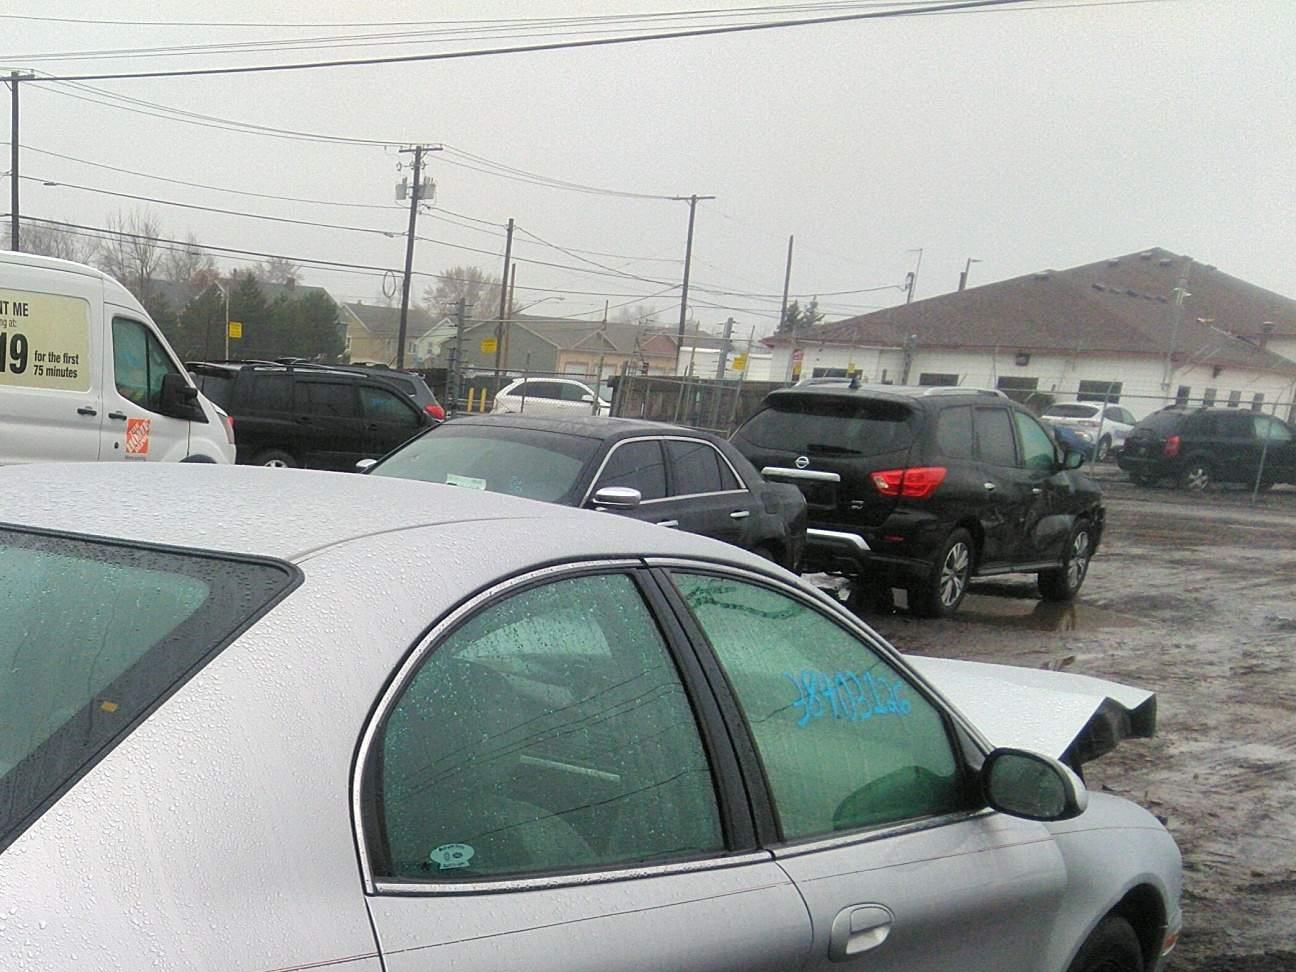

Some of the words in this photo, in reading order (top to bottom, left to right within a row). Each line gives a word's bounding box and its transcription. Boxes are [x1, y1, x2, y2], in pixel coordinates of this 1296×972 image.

[12, 301, 29, 317] ME
[34, 350, 46, 362] for
[48, 351, 61, 363] the
[63, 352, 79, 365] first
[33, 365, 43, 376] 75
[46, 366, 78, 379] minutes
